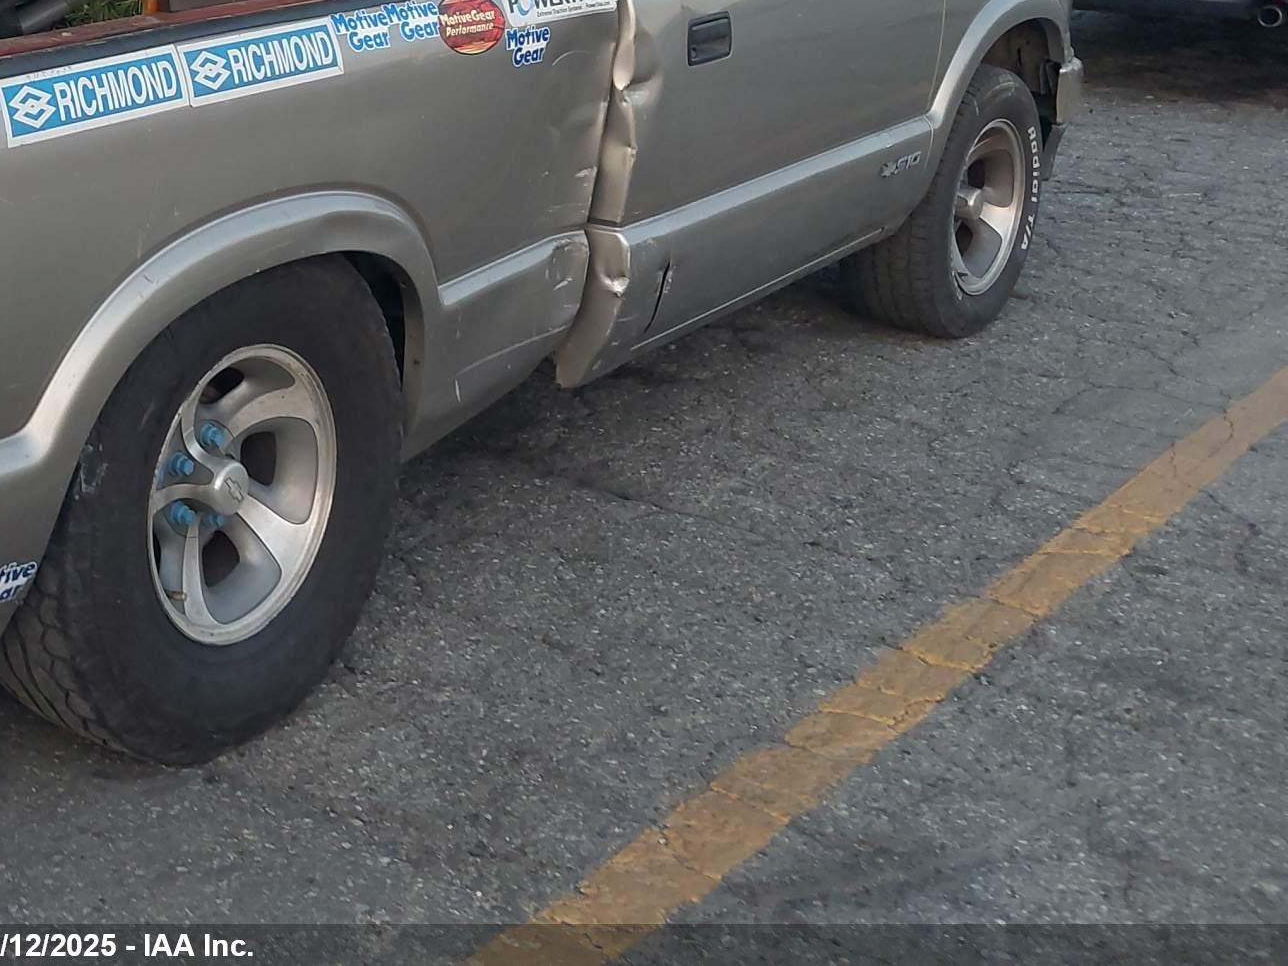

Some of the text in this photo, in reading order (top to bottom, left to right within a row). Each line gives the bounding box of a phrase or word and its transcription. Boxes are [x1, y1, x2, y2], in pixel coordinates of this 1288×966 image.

[331, 10, 389, 33] Motive
[383, 1, 437, 23] Motive
[349, 31, 389, 50] Gear
[401, 21, 439, 40] Gear
[446, 22, 494, 37] Performance
[506, 25, 549, 48] Motive
[229, 31, 333, 84] RICHMOND
[514, 47, 545, 65] Gear
[53, 61, 177, 122] RICHMOND
[1020, 126, 1041, 250] Radial T/A
